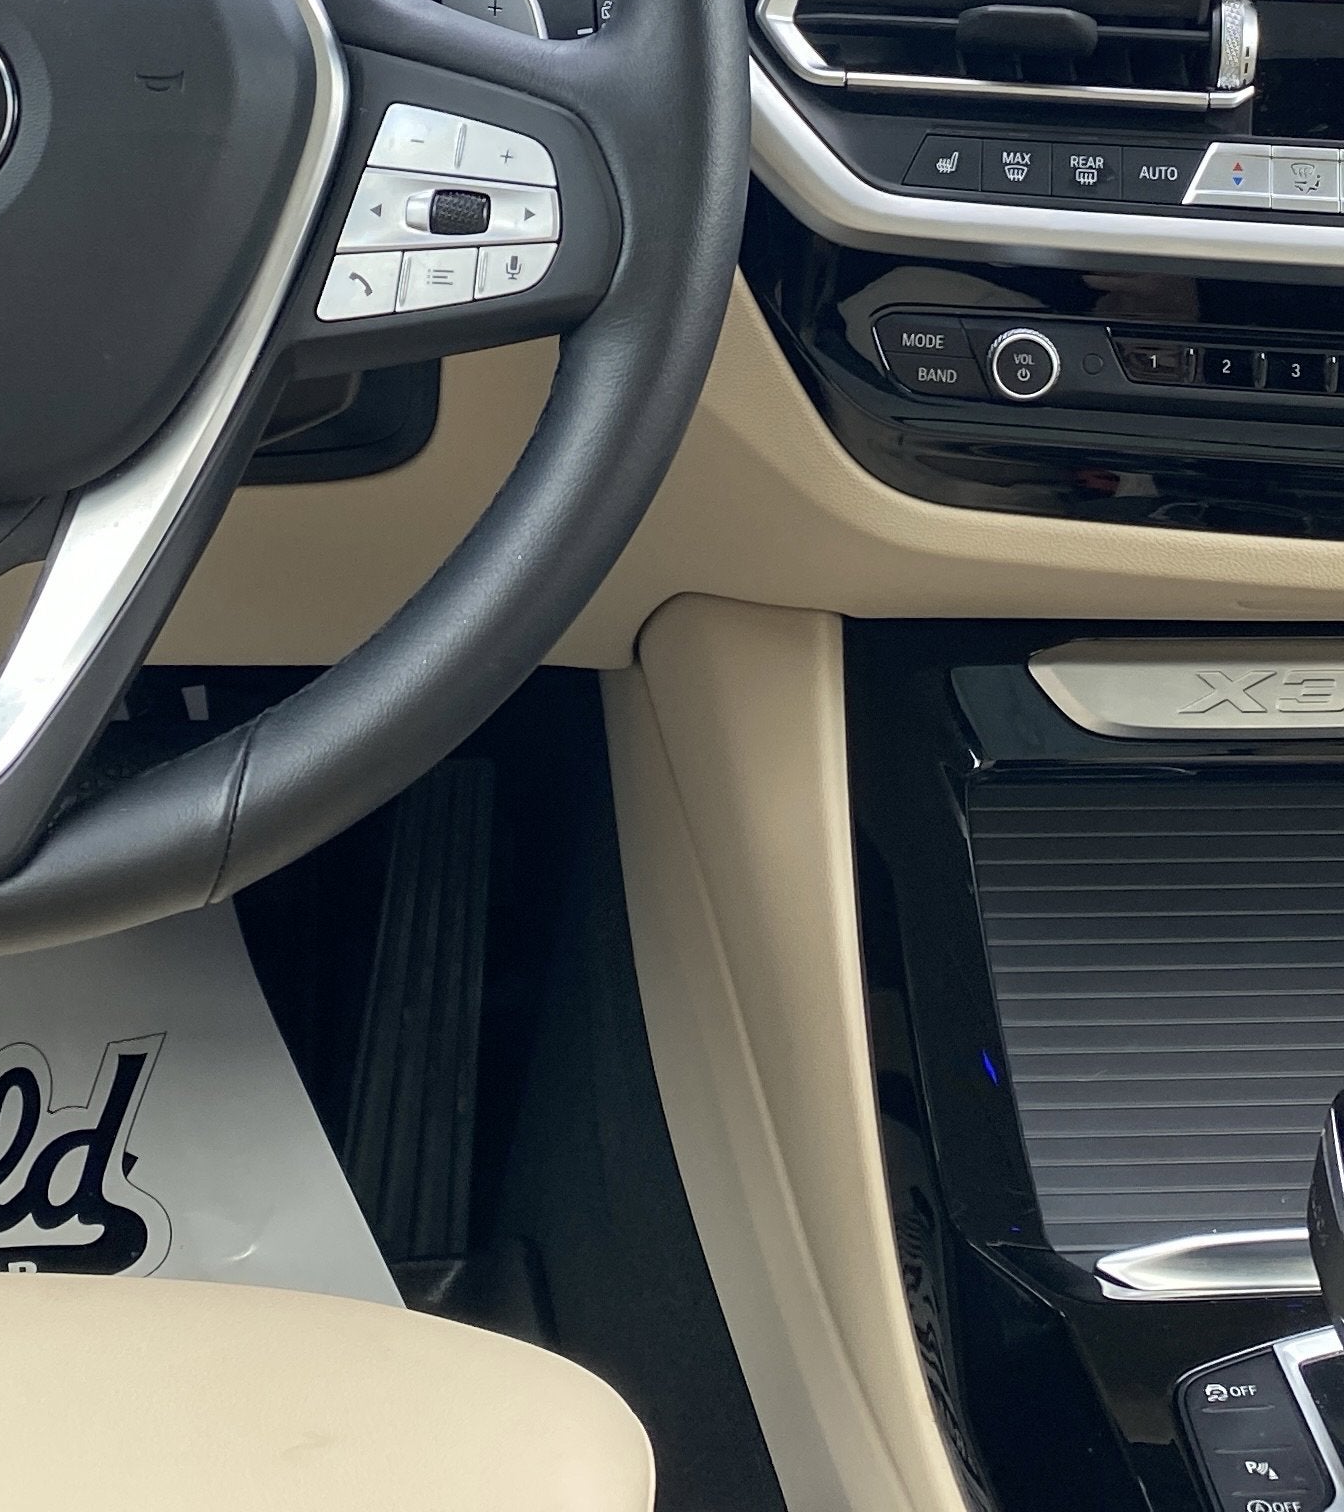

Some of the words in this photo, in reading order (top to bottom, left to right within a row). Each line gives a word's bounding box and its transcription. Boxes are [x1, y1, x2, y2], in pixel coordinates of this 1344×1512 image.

[1001, 151, 1032, 167] MAX
[1069, 155, 1105, 170] REAR
[1138, 164, 1179, 182] AUTO
[901, 332, 946, 350] MODE
[1013, 352, 1036, 367] VOL
[1149, 354, 1158, 369] 1
[1221, 358, 1232, 374] 2
[917, 366, 958, 384] BAND
[1291, 362, 1301, 379] 3
[1229, 1384, 1257, 1398] OFF
[1271, 1501, 1302, 1512] OFF
